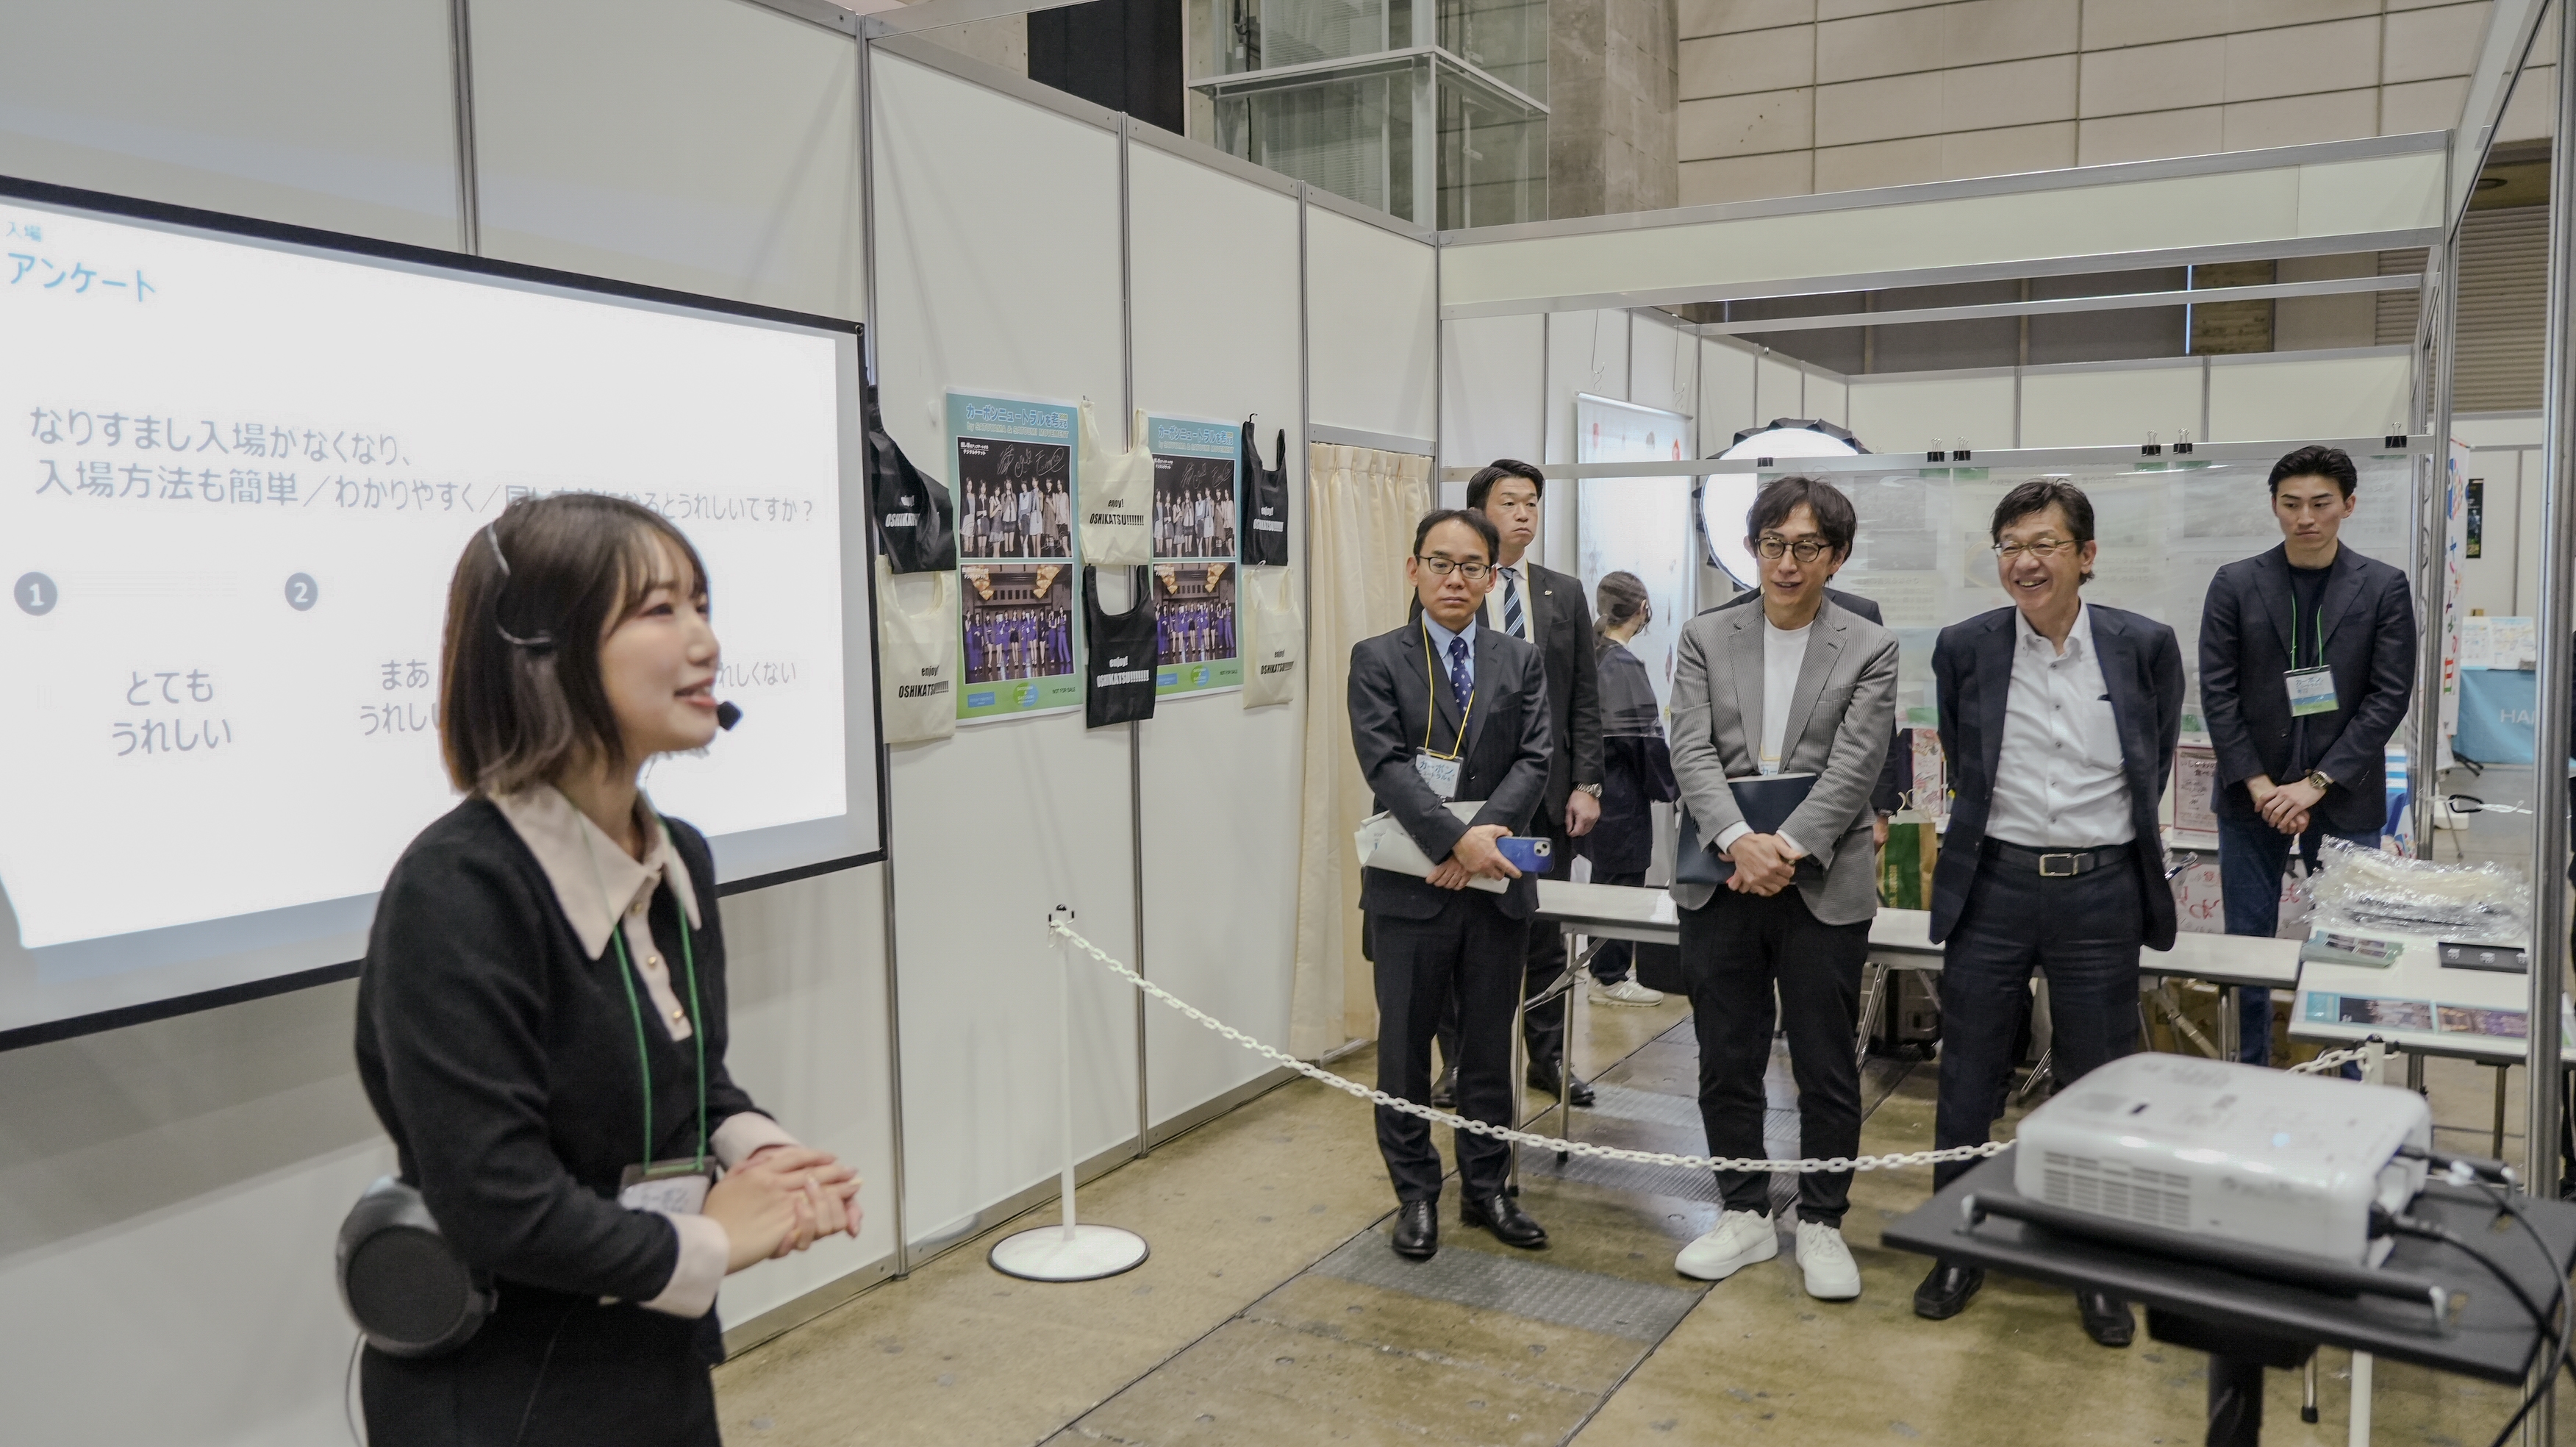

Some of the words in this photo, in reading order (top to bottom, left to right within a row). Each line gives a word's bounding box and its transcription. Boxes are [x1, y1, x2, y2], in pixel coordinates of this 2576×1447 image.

[8, 252, 156, 302] アンケート
[126, 668, 214, 707] とても
[381, 660, 430, 690] まあ
[718, 662, 796, 688] れしくない
[112, 718, 232, 757] うれしい
